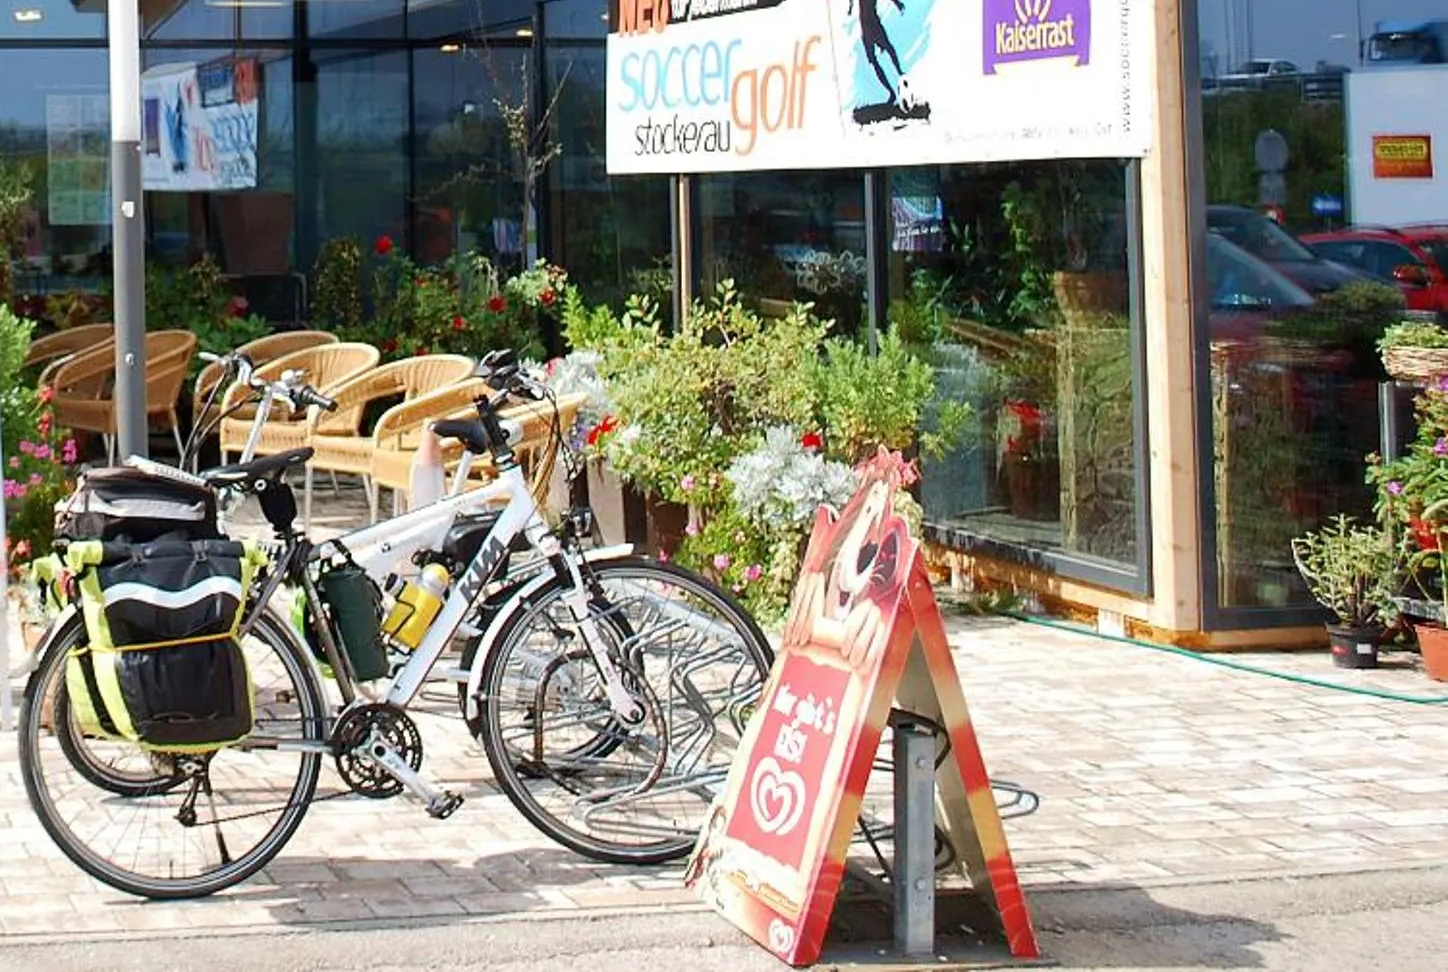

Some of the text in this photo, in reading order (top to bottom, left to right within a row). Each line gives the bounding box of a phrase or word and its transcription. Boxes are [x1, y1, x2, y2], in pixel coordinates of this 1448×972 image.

[995, 13, 1075, 55] Kaiserrast
[618, 35, 822, 156] soccer golf
[635, 113, 731, 156] stockerau
